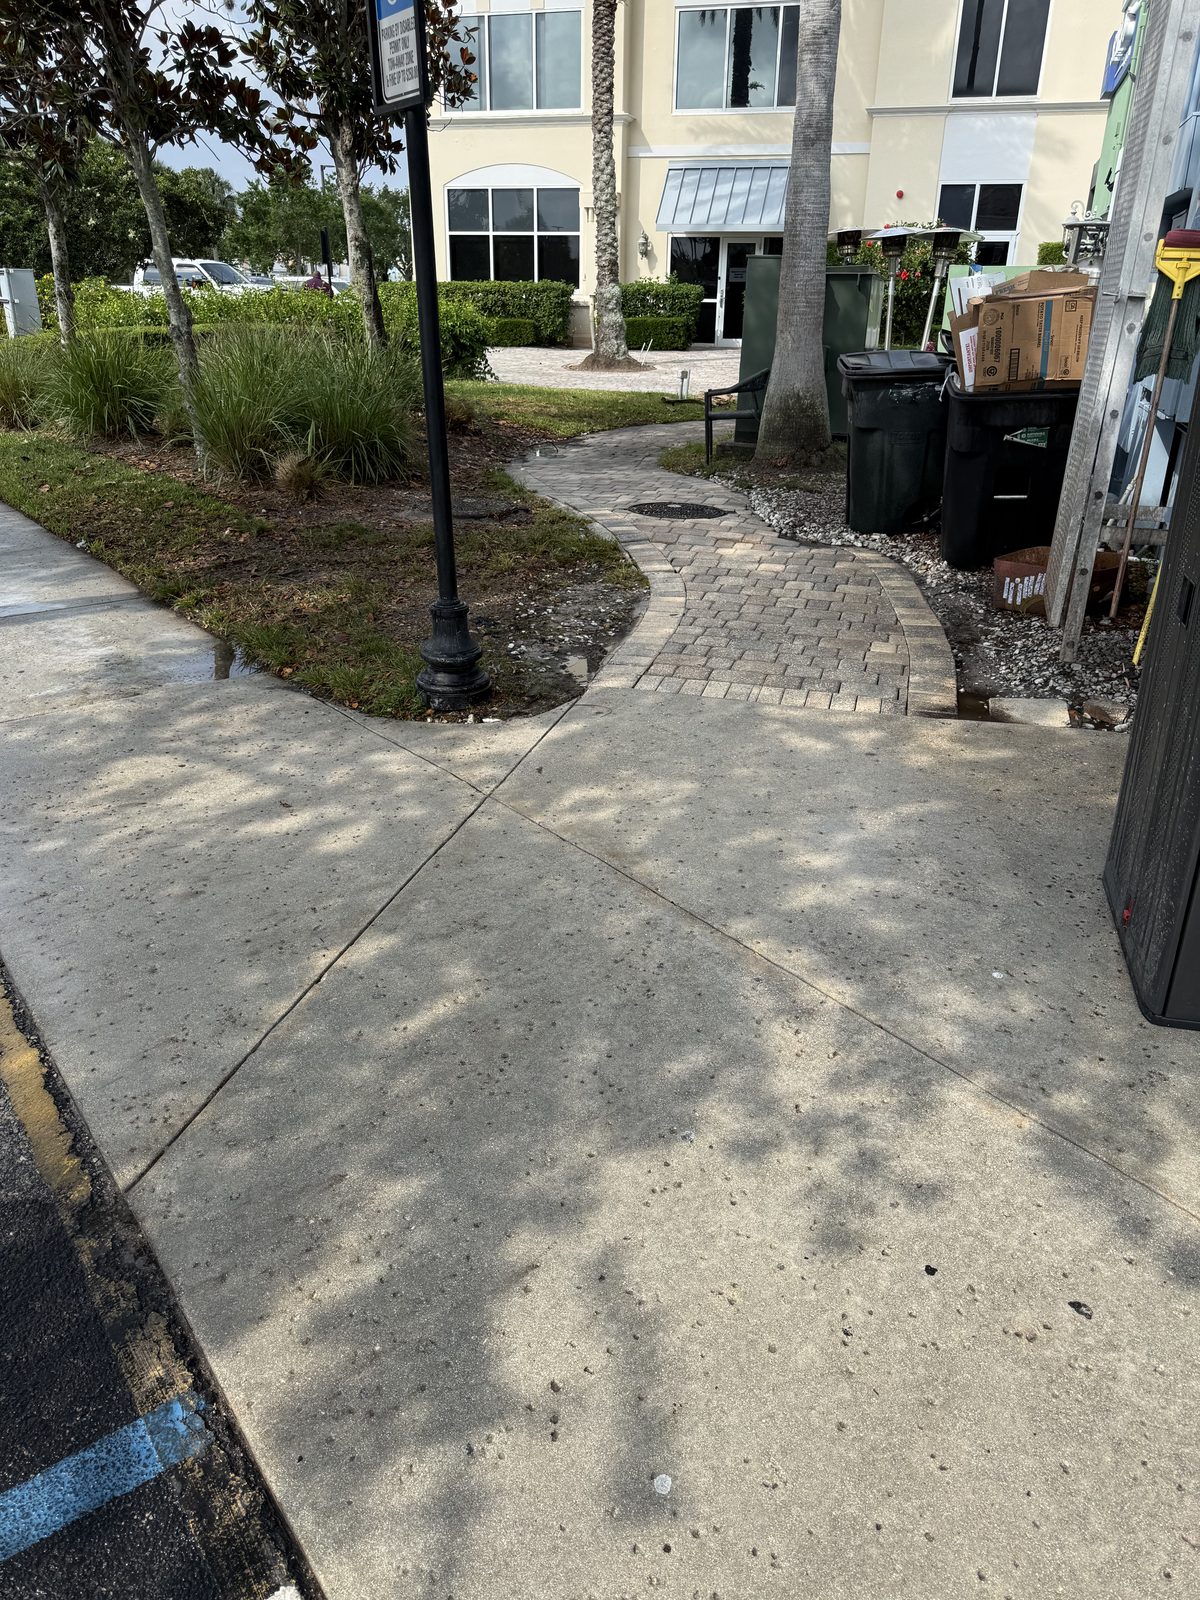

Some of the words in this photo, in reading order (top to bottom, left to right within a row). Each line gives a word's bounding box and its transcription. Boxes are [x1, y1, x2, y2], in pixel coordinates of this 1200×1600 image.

[382, 24, 395, 41] PARKING
[389, 39, 401, 55] PERMIT
[405, 50, 414, 65] ZONE
